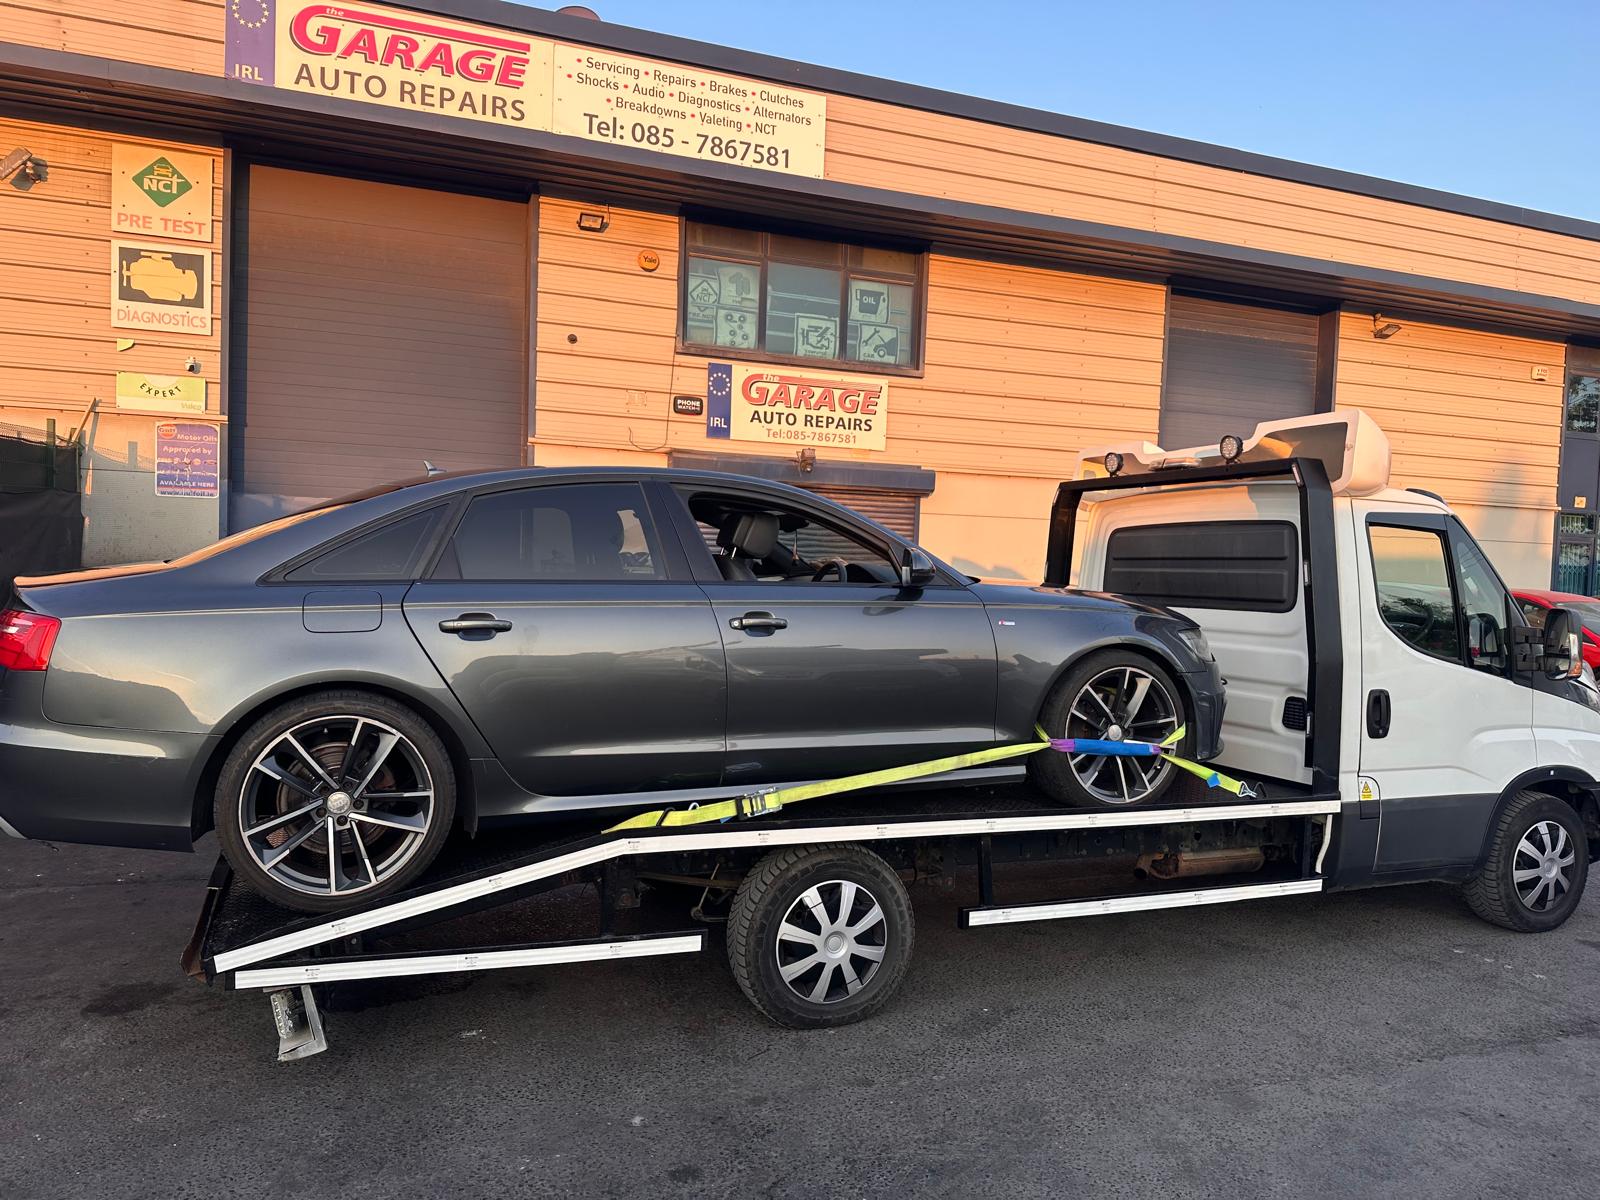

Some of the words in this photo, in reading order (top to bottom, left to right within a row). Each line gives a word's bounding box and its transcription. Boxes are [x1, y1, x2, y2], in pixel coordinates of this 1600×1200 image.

[325, 6, 345, 17] the
[289, 4, 531, 90] GARAGE
[233, 63, 264, 82] IRL
[586, 56, 640, 79] Servicing
[653, 69, 697, 88] Repairs
[709, 80, 748, 98] Brakes
[759, 90, 805, 109] Clutches
[294, 63, 387, 99] AUTO
[399, 80, 526, 122] REPAIRS
[576, 73, 620, 91] Shocks
[632, 83, 665, 99] Audio
[678, 91, 741, 113] Diagnostics
[753, 105, 812, 126] Alternators
[615, 97, 687, 121] Breakdowns
[699, 112, 743, 132] Valeting
[755, 123, 777, 136] NCT
[583, 113, 625, 141] Tel:
[631, 122, 675, 148] 085
[696, 134, 790, 169] 7867581
[117, 212, 152, 230] PRE
[160, 217, 206, 236] TEST
[862, 295, 876, 305] OIL
[763, 374, 780, 382] the
[139, 382, 182, 398] EXPERT
[741, 373, 883, 416] GARAGE
[677, 399, 701, 407] PHONE
[710, 417, 728, 429] IRL
[750, 410, 797, 427] AUTO
[804, 415, 873, 432] REPAIRS
[766, 428, 857, 445] Tel:085-7867581
